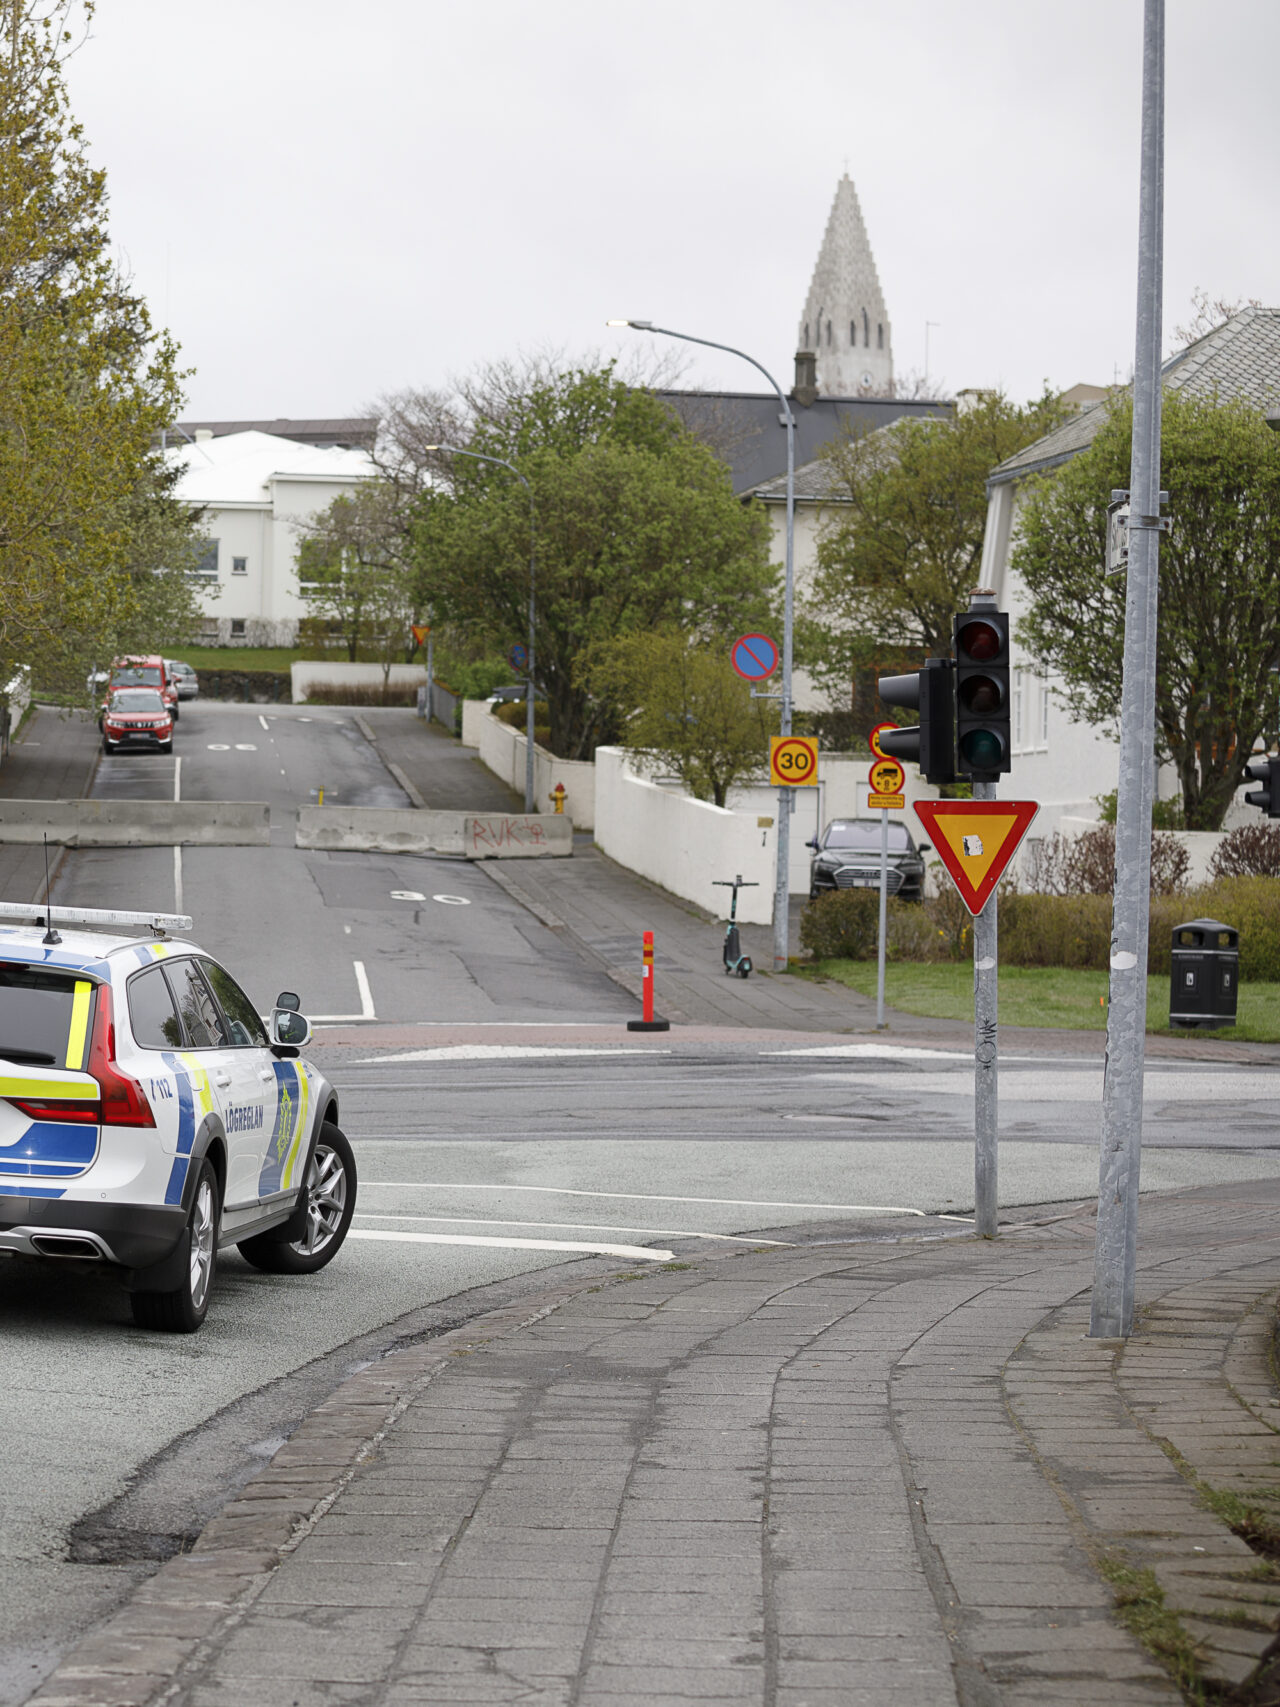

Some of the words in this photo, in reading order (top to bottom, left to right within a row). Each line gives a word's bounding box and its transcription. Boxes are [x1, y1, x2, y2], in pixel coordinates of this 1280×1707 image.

[780, 752, 809, 770] 30
[472, 817, 525, 850] RVK
[390, 890, 472, 905] 30
[155, 1078, 173, 1100] 112
[224, 1101, 264, 1134] LÖGREGLAN
